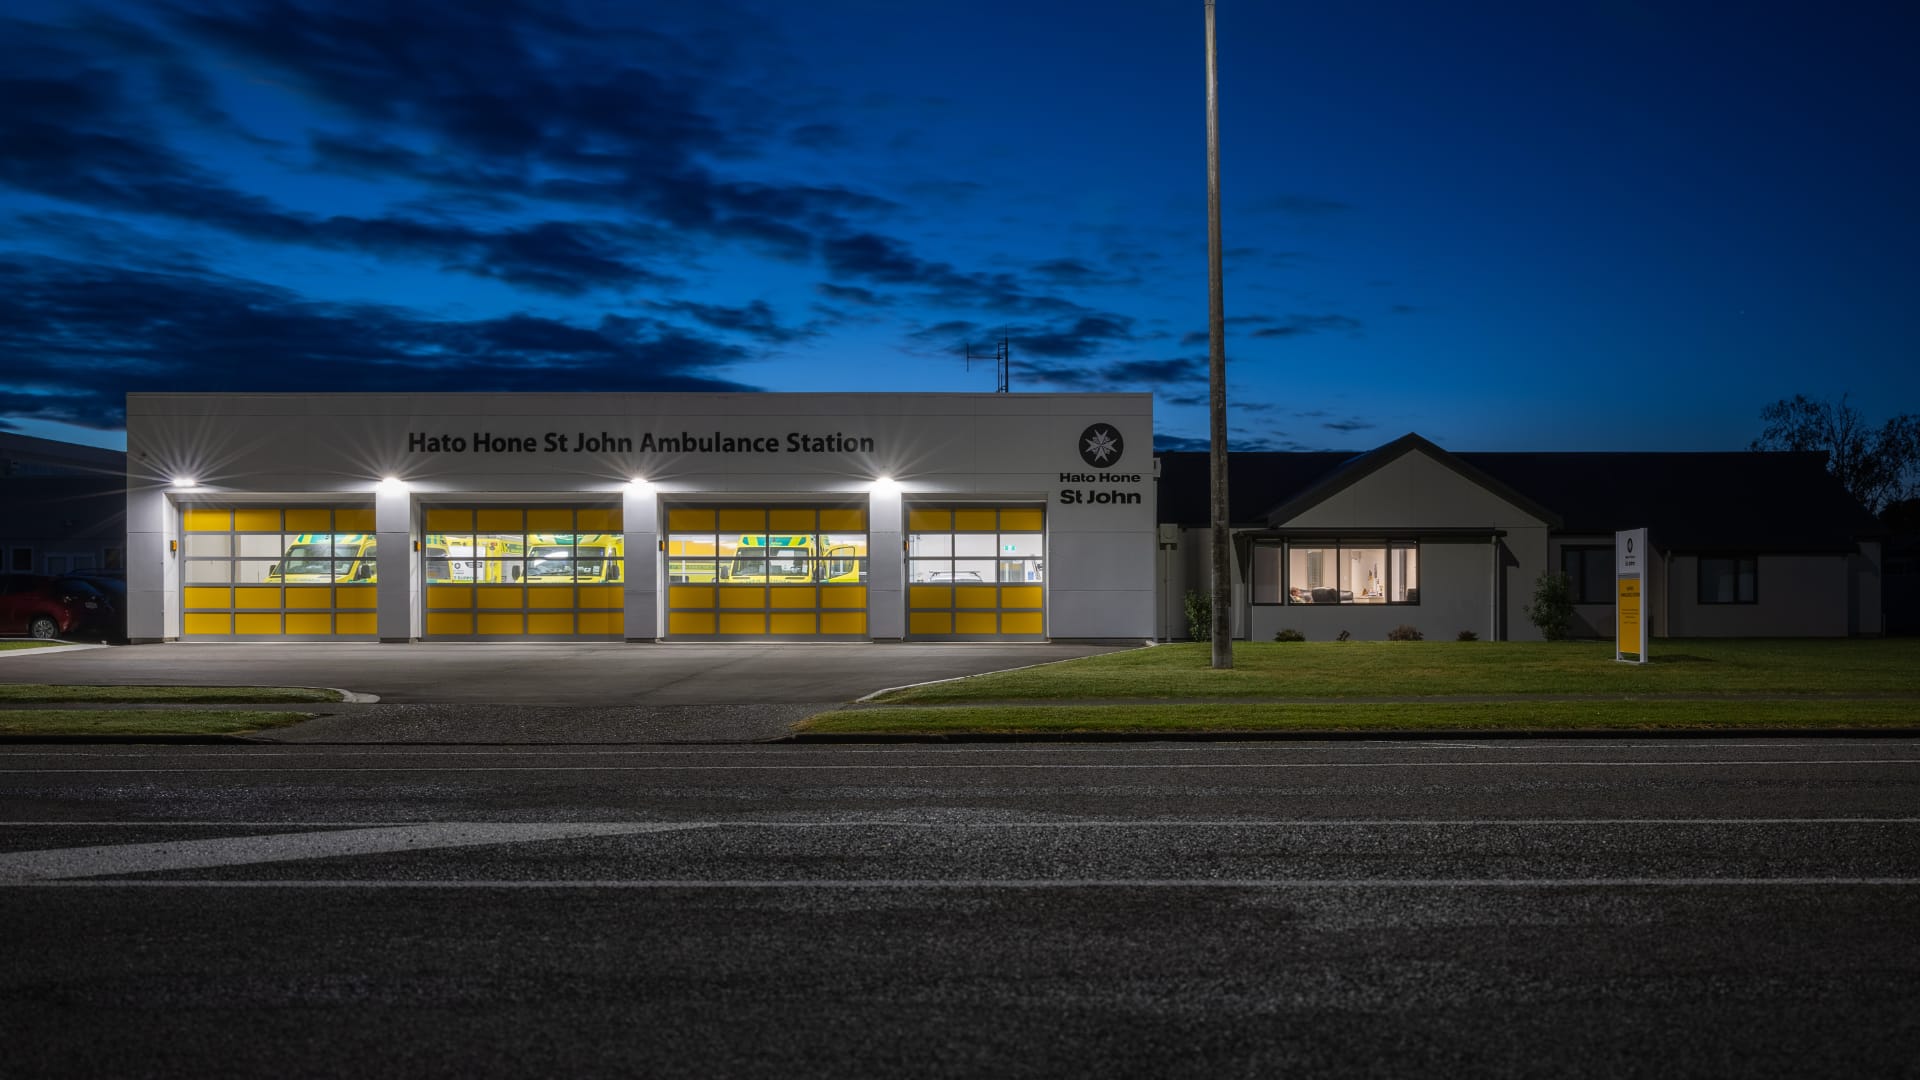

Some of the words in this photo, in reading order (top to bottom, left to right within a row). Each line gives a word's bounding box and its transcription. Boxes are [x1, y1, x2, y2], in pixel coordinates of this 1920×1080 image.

[408, 432, 467, 453] Hato
[473, 432, 538, 453] Hone
[543, 432, 568, 453] St
[572, 432, 633, 454] John
[639, 432, 780, 453] Ambulance
[786, 432, 874, 453] Station
[1060, 473, 1096, 483] Hato
[1099, 473, 1141, 483] Hone
[1060, 489, 1083, 505] St
[1086, 490, 1141, 505] John
